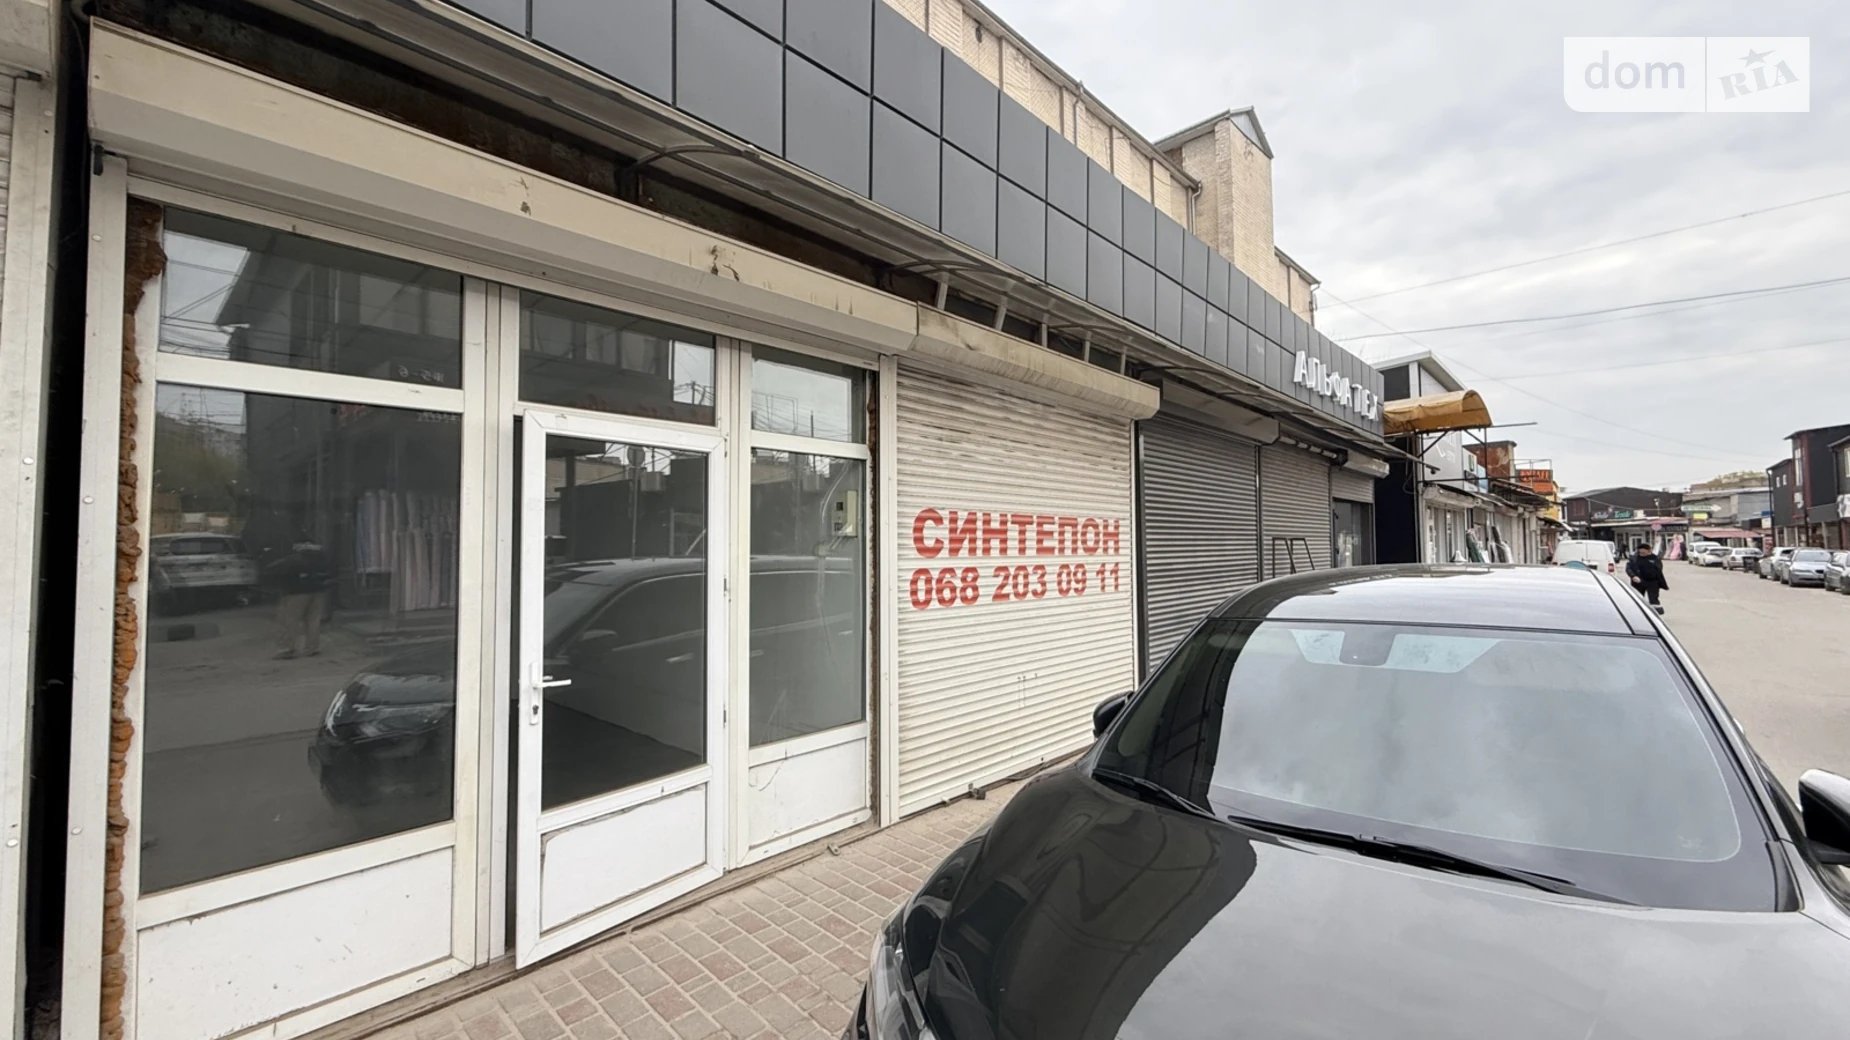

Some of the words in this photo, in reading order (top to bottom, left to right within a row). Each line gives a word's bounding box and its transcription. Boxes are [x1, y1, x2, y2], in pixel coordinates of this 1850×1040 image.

[912, 508, 1120, 559] СИНТЕПОН
[909, 567, 980, 610] 068
[991, 564, 1047, 602] 203
[1056, 563, 1087, 597] 09
[1096, 562, 1120, 592] 11
